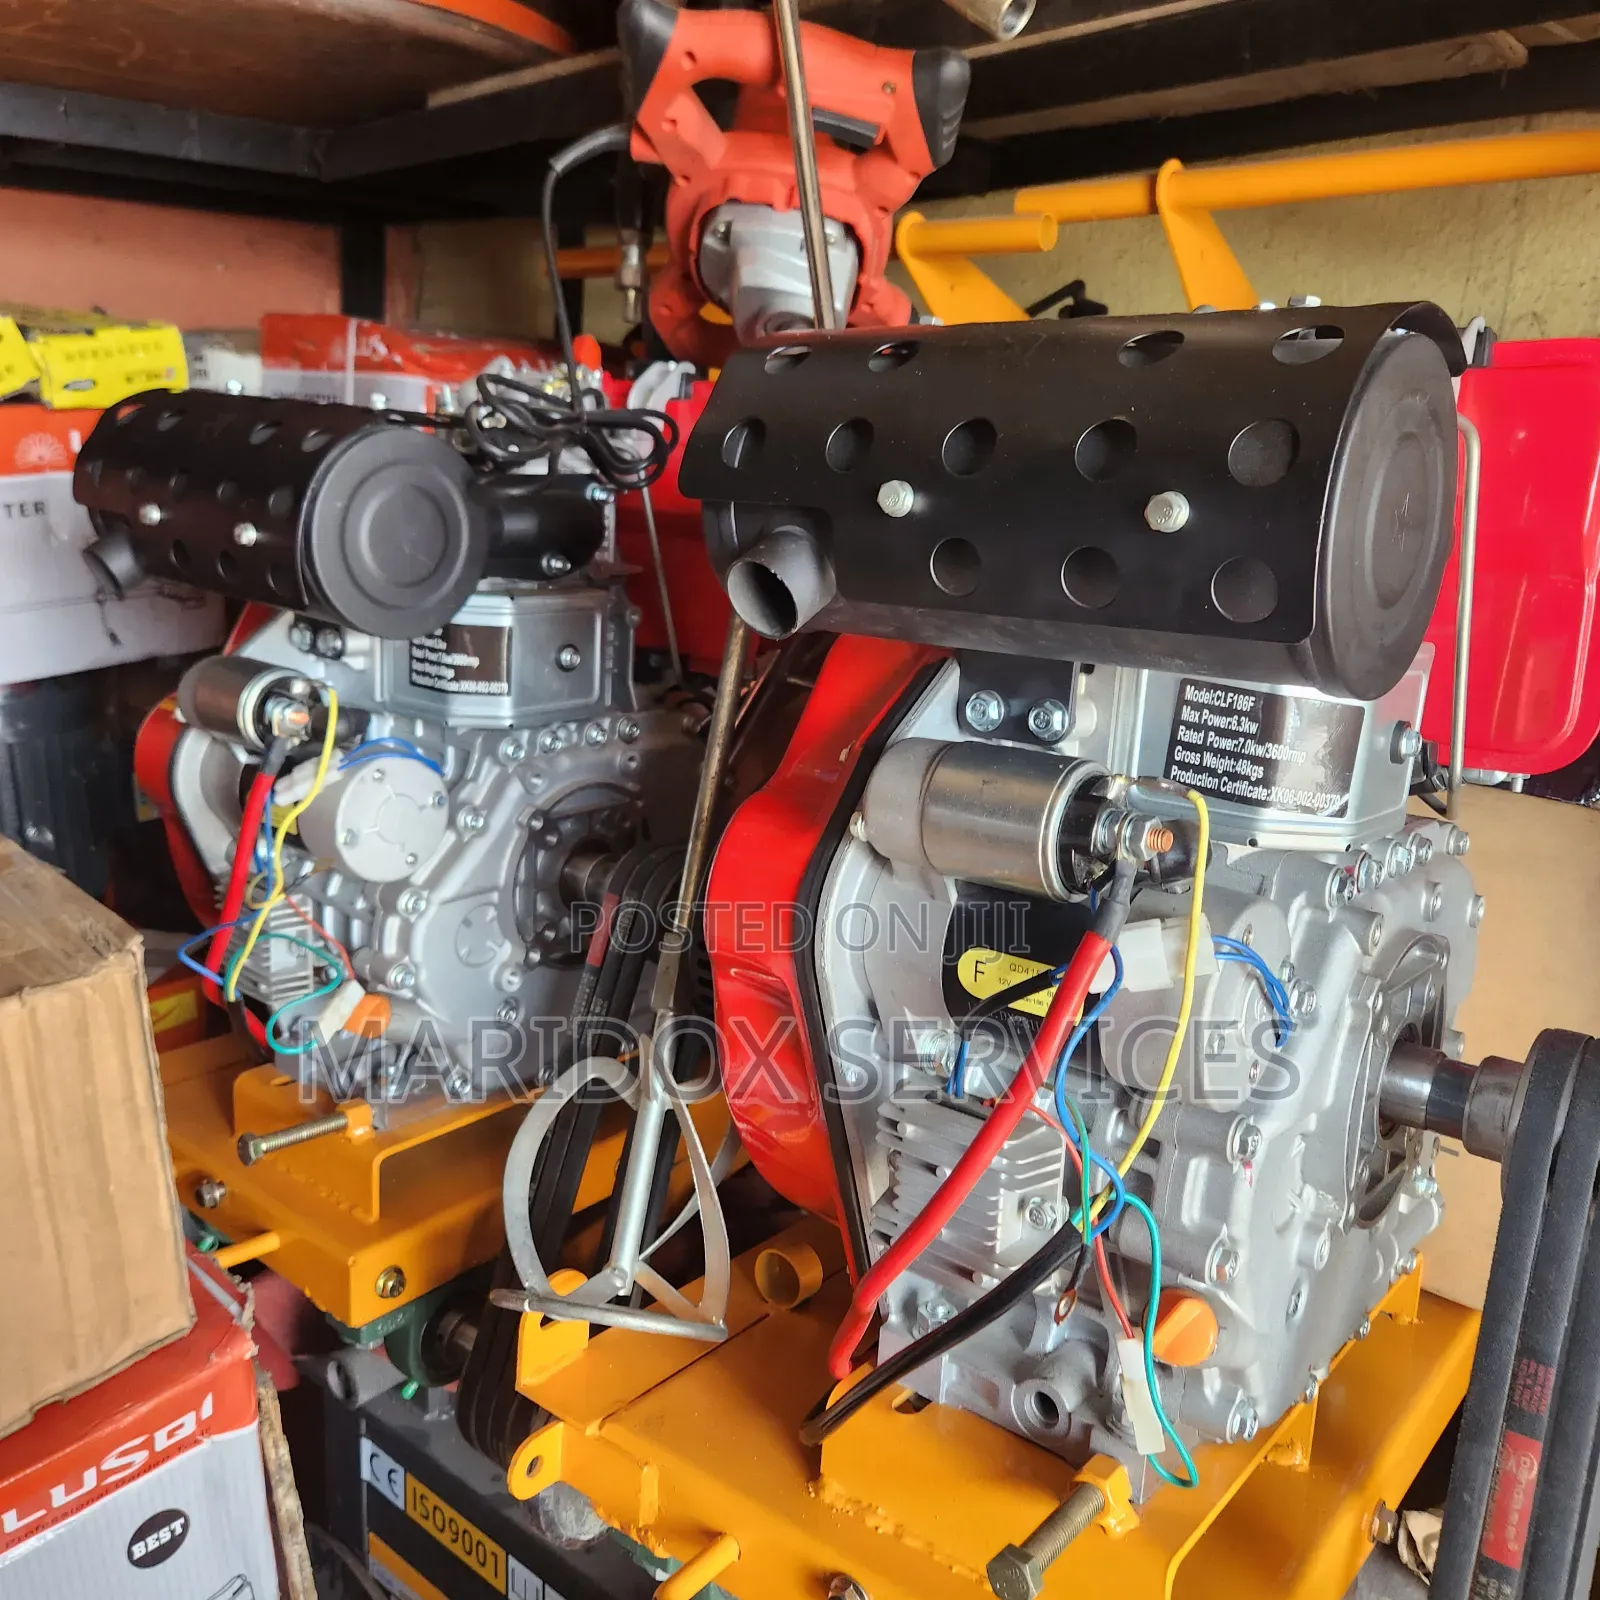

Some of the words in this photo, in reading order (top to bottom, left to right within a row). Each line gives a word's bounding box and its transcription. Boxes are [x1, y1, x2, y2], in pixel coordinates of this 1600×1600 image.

[1184, 684, 1256, 713] Model:CLF186F
[1181, 705, 1200, 724] Max
[1201, 708, 1260, 736] Power:6.3kw
[1174, 745, 1201, 767] Gross
[1203, 750, 1265, 782] Weight:48kgs
[1176, 725, 1205, 746] Rated
[1207, 728, 1307, 765] Power:7.0kw/3600rmp
[1170, 764, 1220, 790] Production
[973, 959, 987, 983] F
[1, 1391, 213, 1534] LUSQI
[131, 1517, 186, 1561] BEST
[412, 1486, 499, 1579] ISO9001
